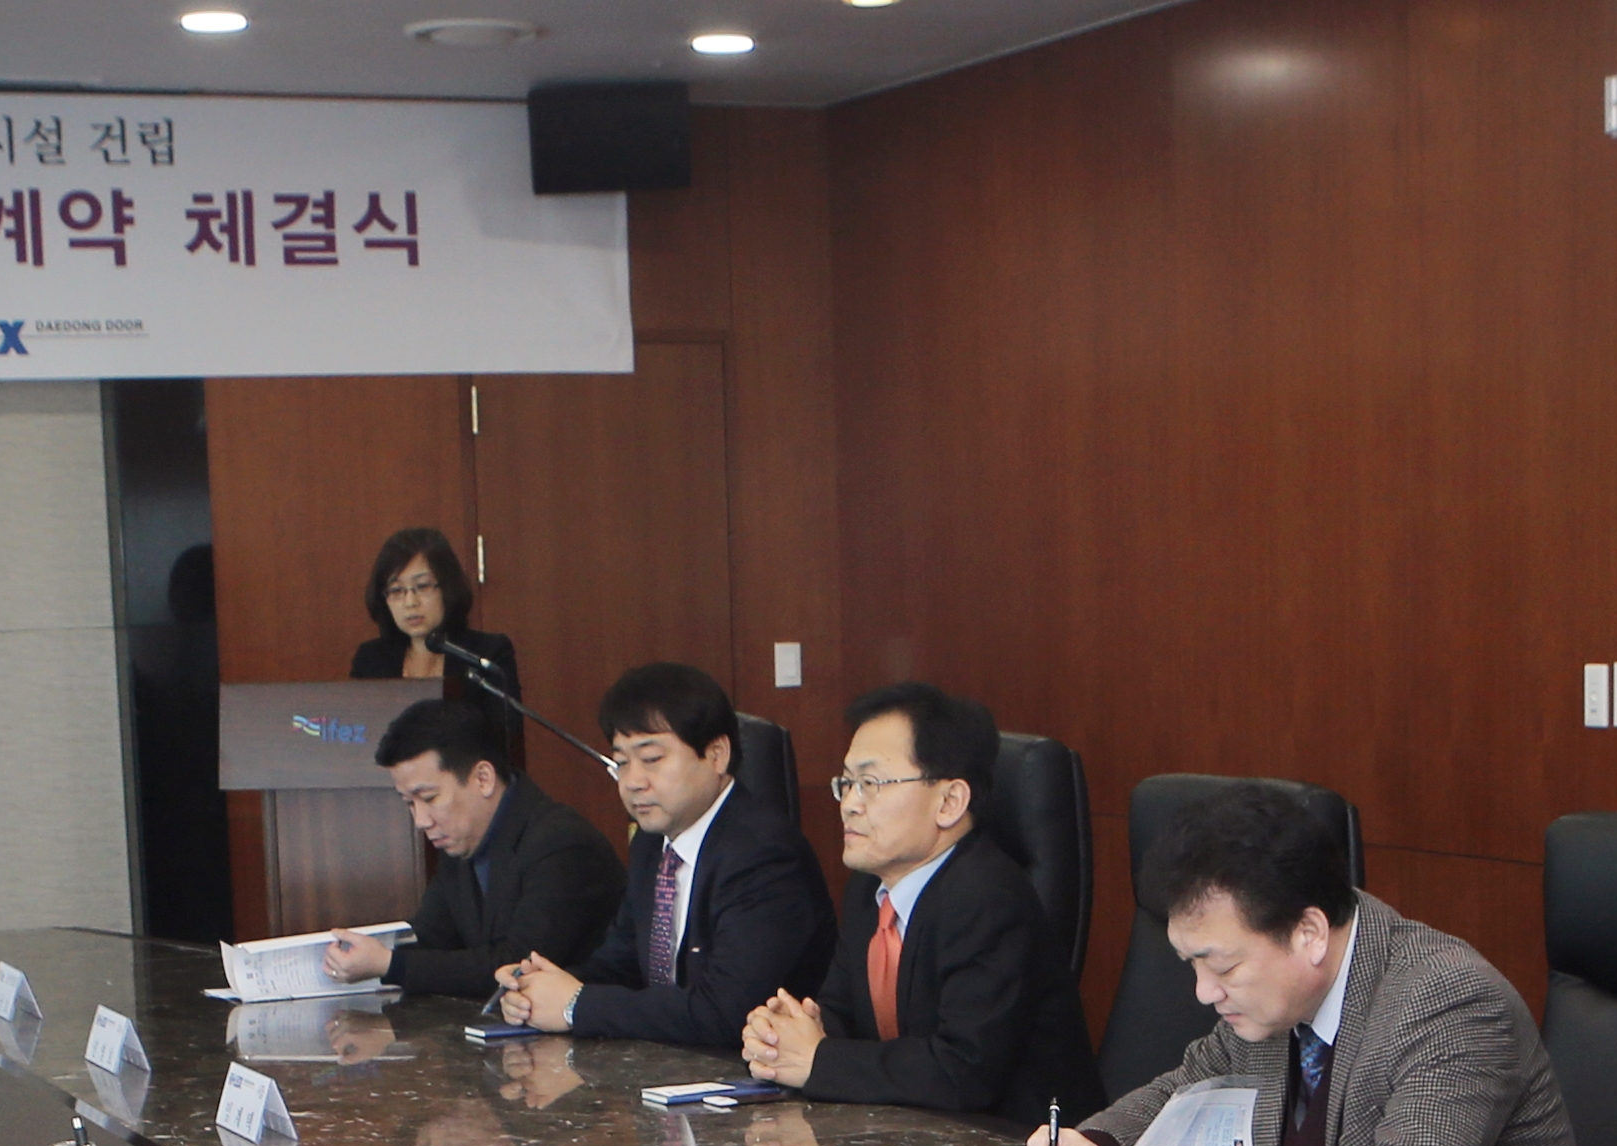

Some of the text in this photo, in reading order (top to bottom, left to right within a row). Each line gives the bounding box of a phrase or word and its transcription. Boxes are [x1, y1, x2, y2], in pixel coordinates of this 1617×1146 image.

[92, 117, 176, 168] 건립
[184, 188, 422, 270] 체결식
[34, 318, 145, 333] DAEDONG DOOR
[319, 718, 368, 744] ifez
